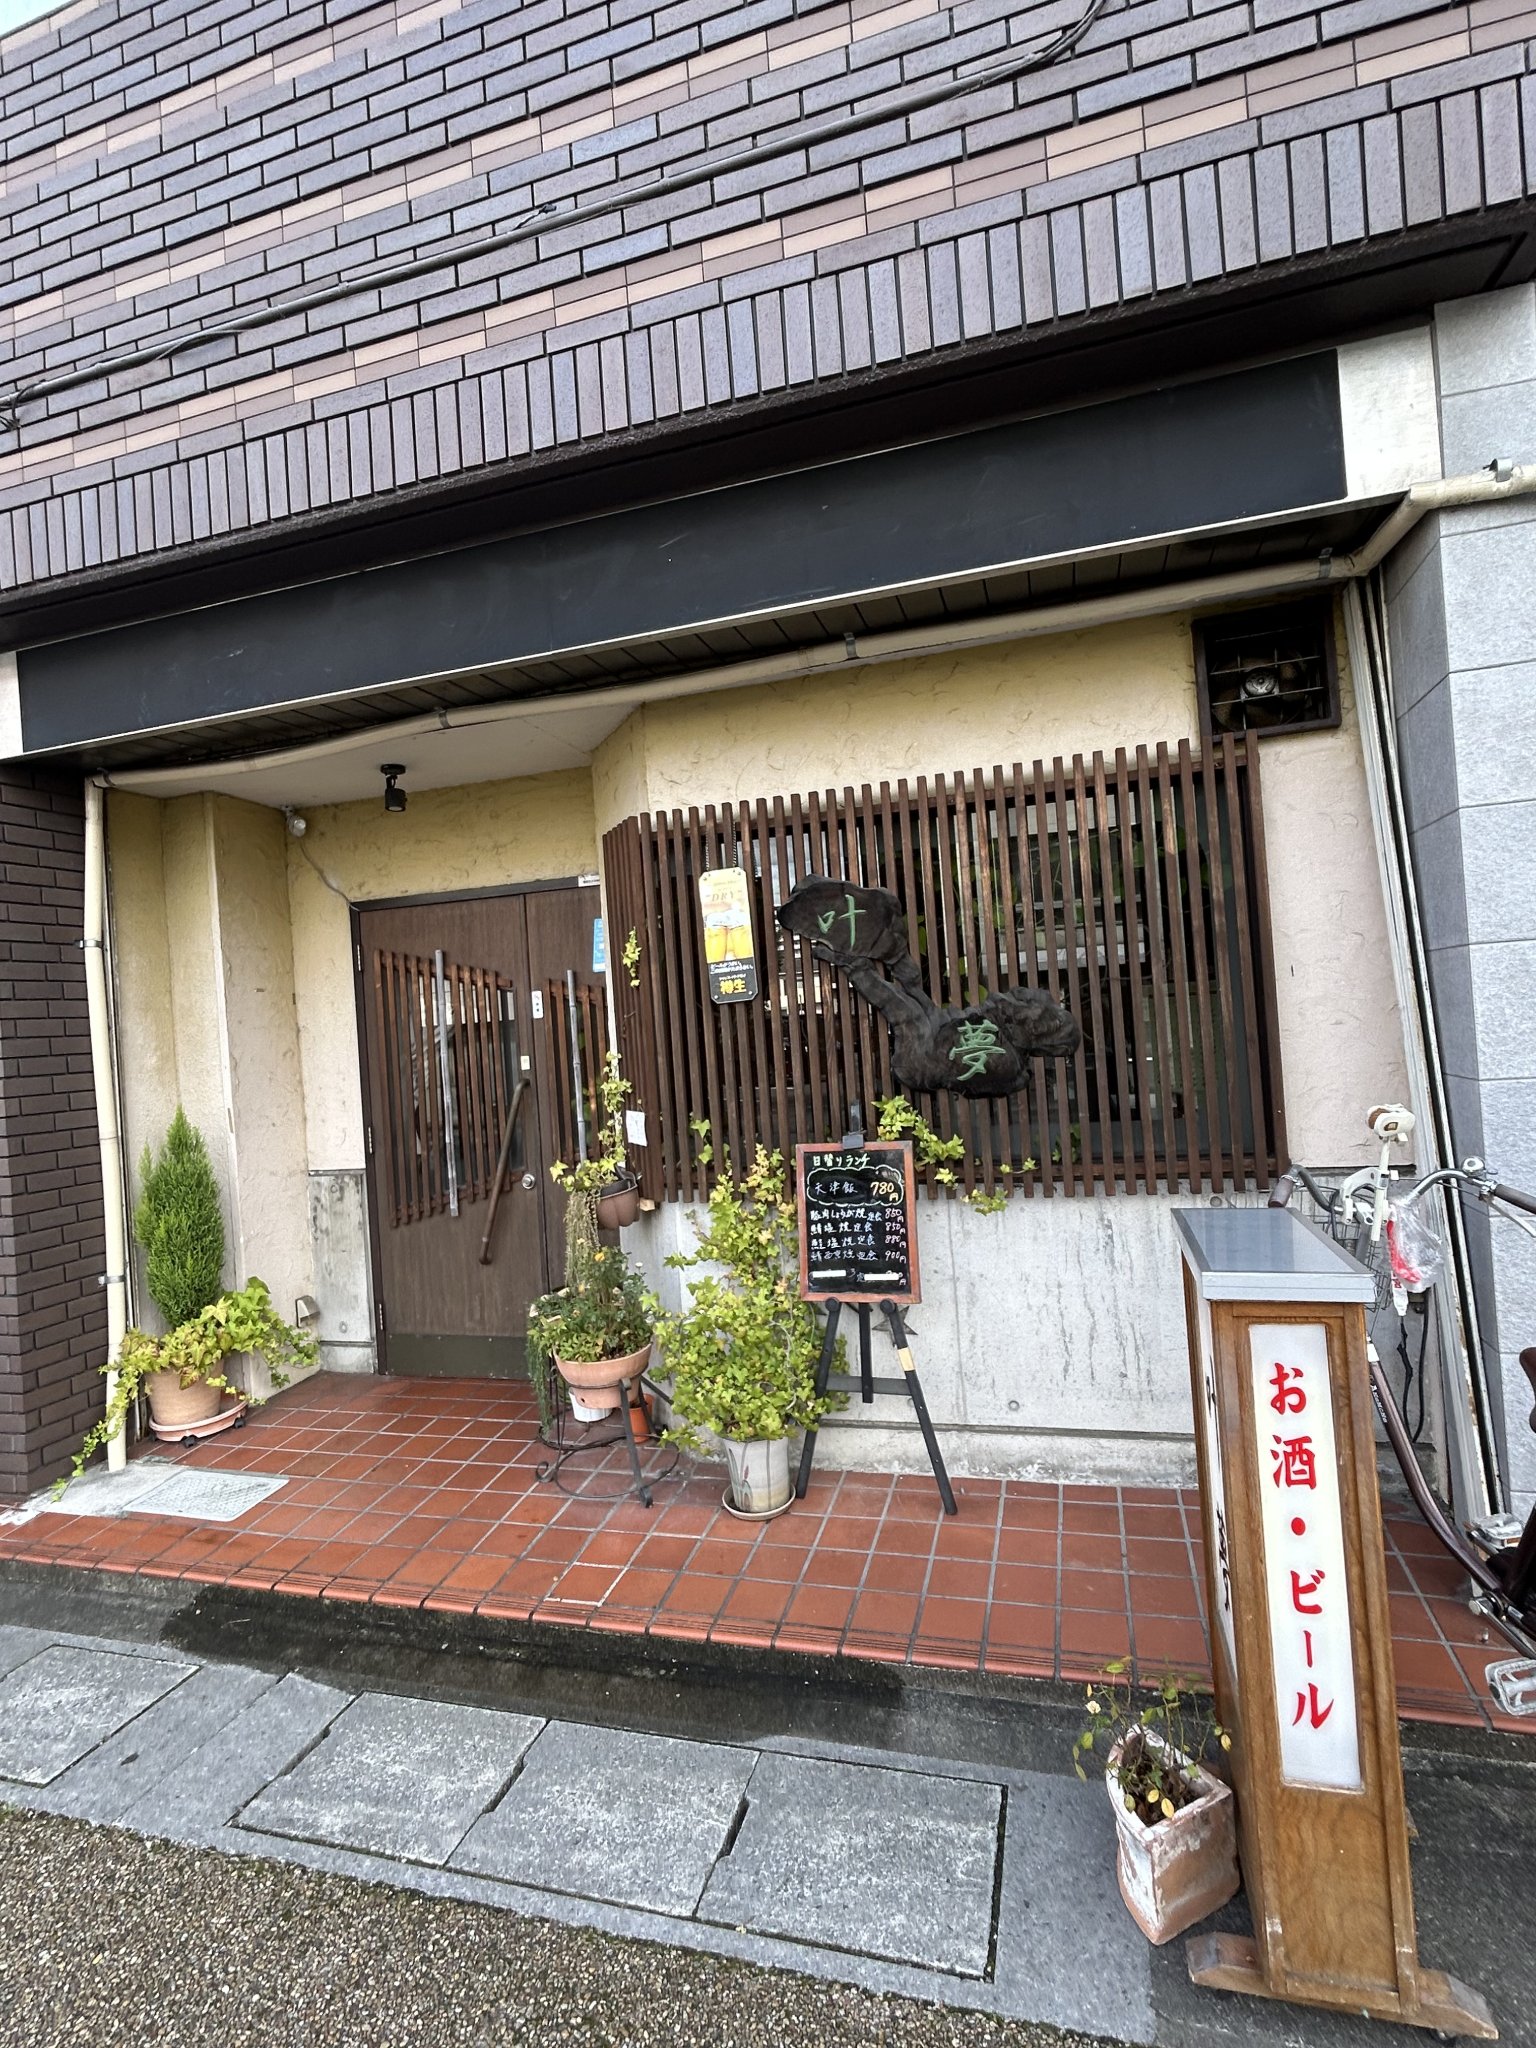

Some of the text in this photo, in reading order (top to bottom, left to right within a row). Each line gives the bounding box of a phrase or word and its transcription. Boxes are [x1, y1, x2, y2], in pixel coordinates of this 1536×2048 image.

[817, 893, 866, 949] 叶
[949, 1018, 1007, 1082] 夢
[812, 1152, 871, 1169] 日替りランチ
[814, 1180, 858, 1195] 天津飯
[1268, 1361, 1336, 1730] お酒・ビール
